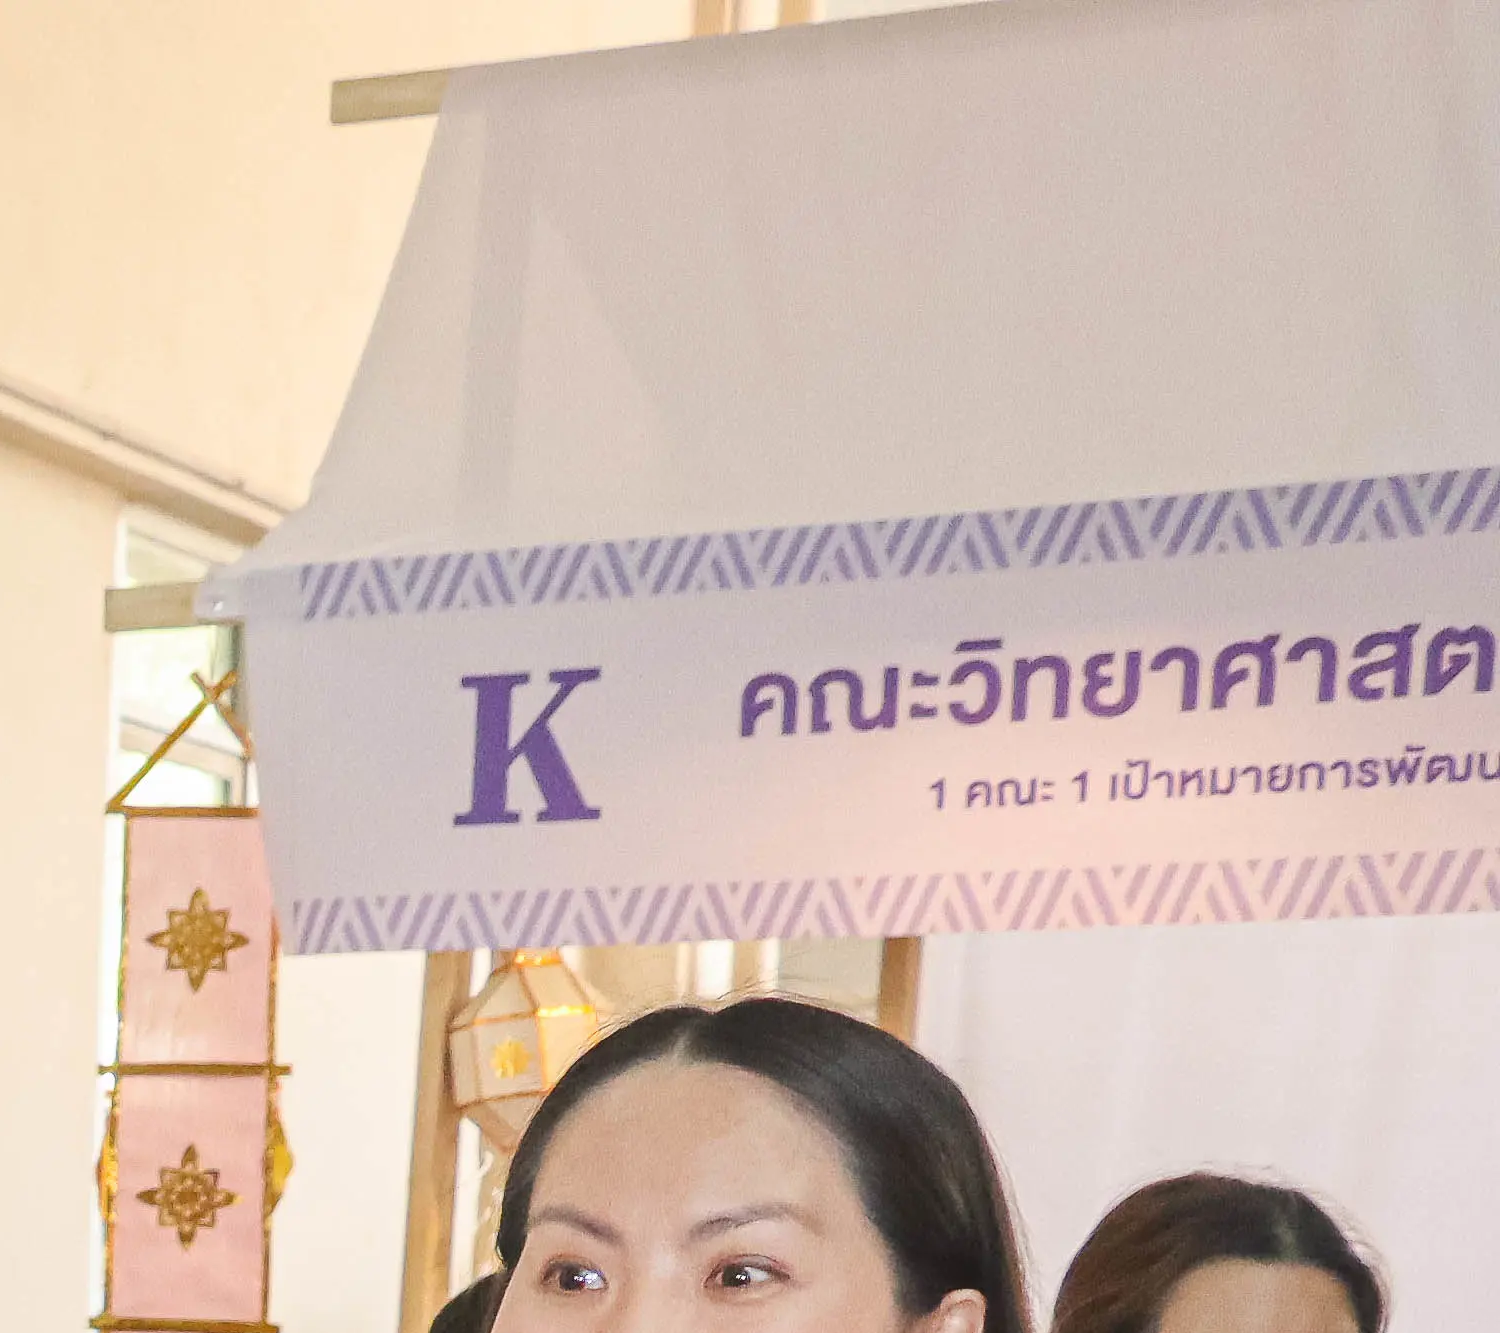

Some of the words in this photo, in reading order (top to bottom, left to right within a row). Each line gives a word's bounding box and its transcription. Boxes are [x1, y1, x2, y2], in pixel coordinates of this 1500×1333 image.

[453, 667, 602, 826] K
[929, 777, 947, 809] 1
[965, 777, 1055, 807] คณะ
[1071, 770, 1090, 801] 1
